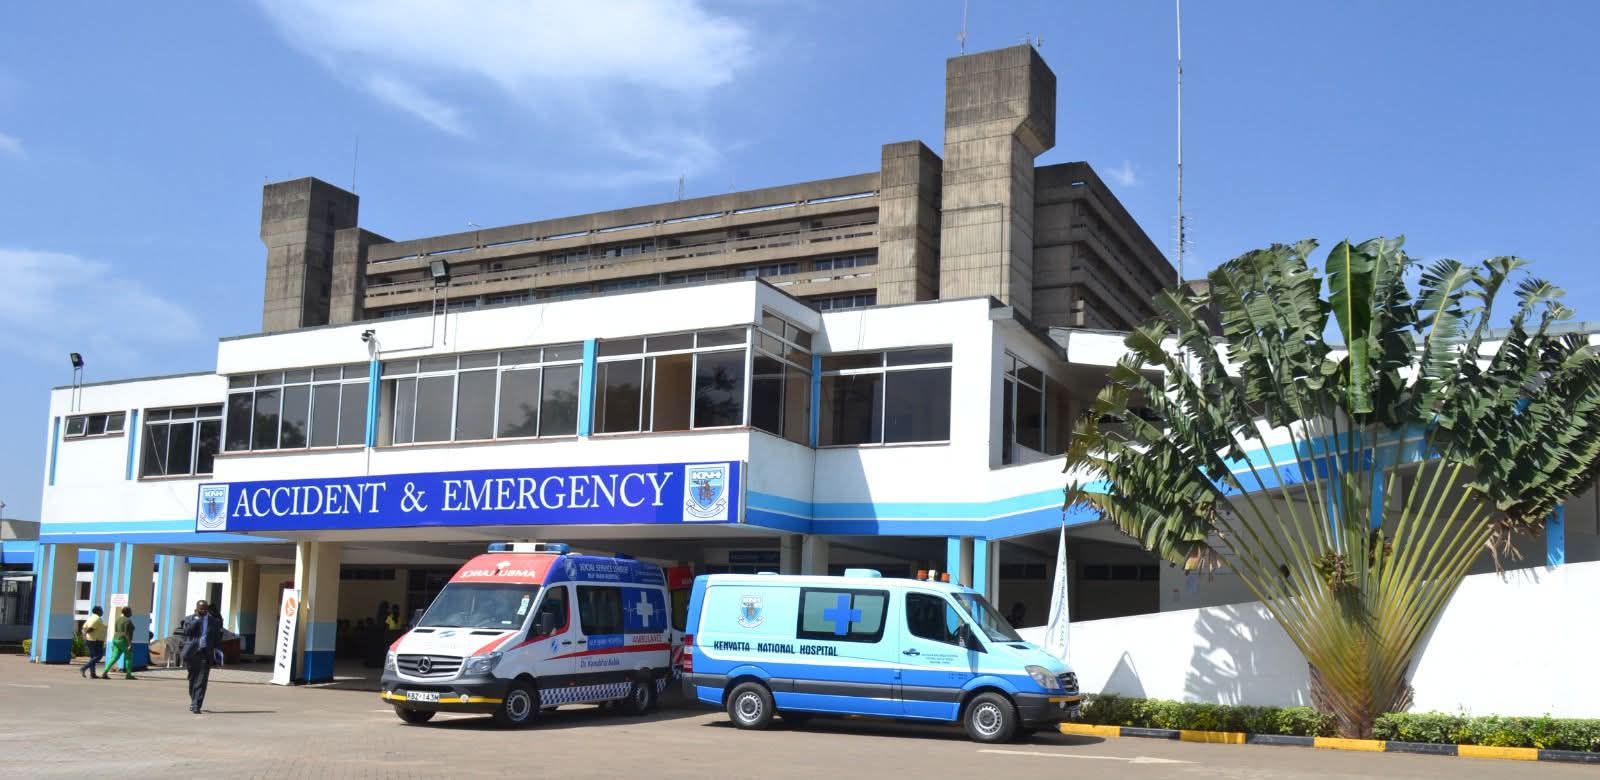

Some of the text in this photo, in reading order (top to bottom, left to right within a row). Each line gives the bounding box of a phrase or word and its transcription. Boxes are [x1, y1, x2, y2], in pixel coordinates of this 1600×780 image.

[231, 472, 673, 516] ACCIDENT & EMERGENCY
[713, 640, 838, 656] KENYATTA NATIONAL HOSPITAL
